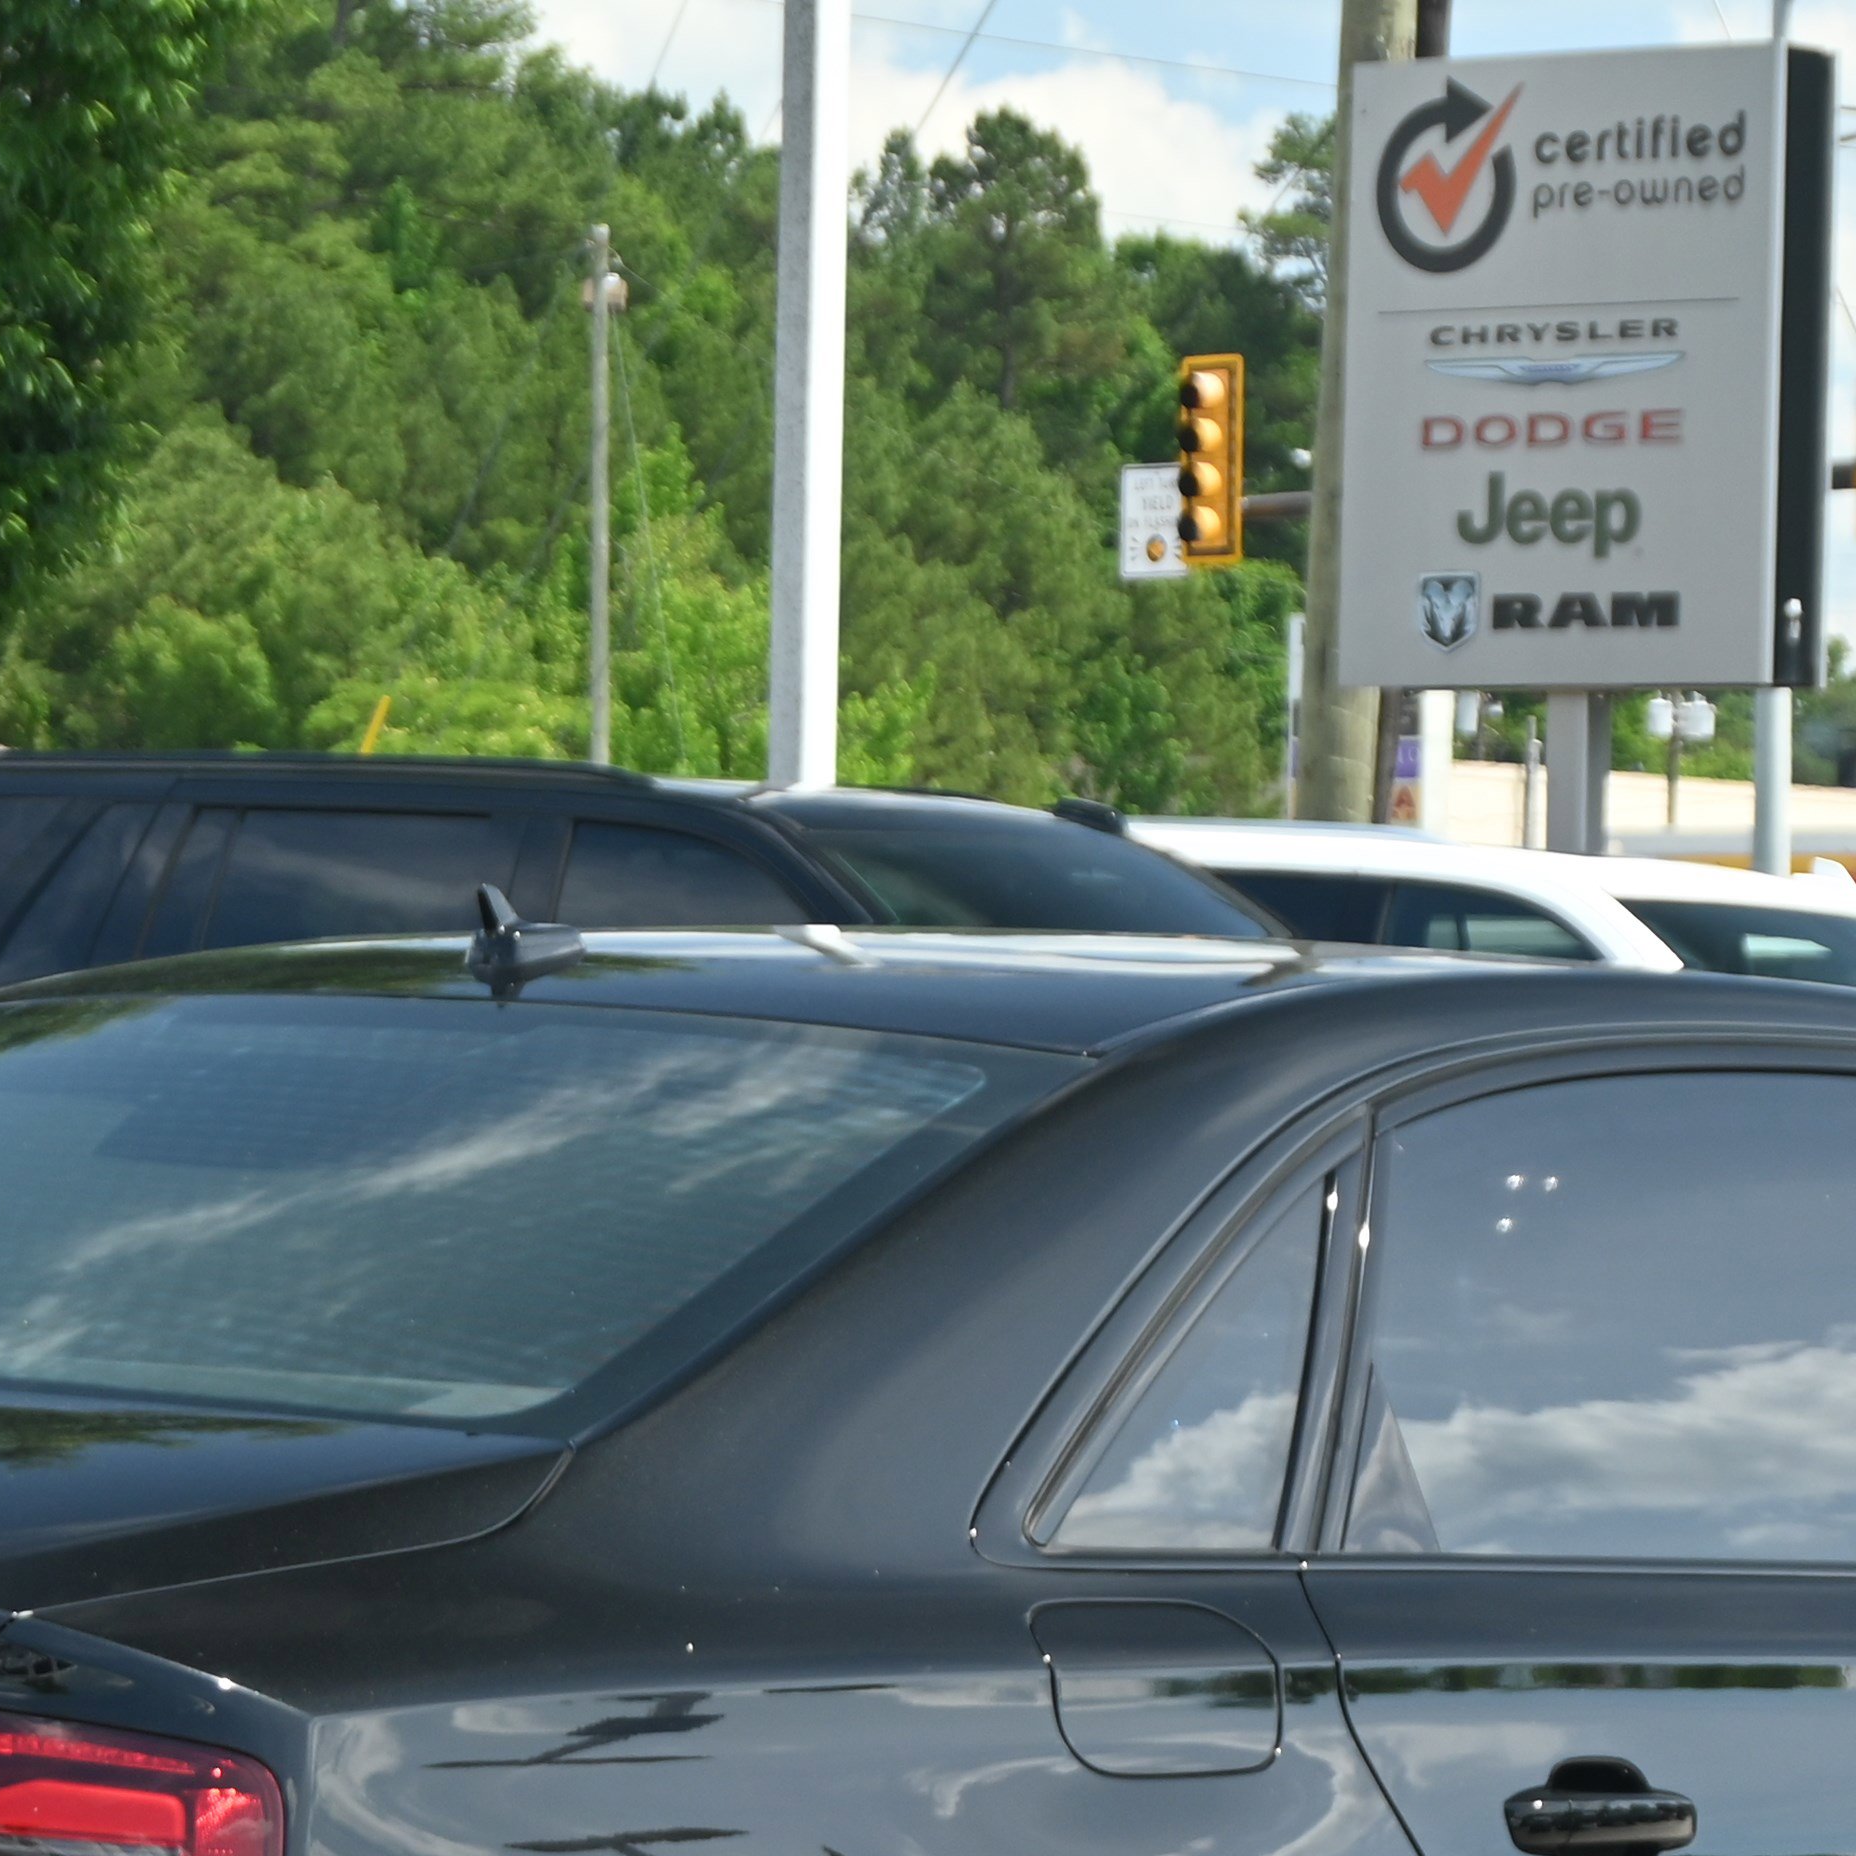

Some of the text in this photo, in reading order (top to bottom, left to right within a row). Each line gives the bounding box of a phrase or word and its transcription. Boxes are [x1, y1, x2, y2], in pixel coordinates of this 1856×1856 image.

[1534, 108, 1747, 165] certified
[1532, 163, 1745, 219] pre-owned
[1428, 317, 1680, 346] CHRYSLER
[1421, 408, 1684, 449] DODGE
[1456, 470, 1642, 558] Jeep
[1492, 591, 1681, 630] RAM
